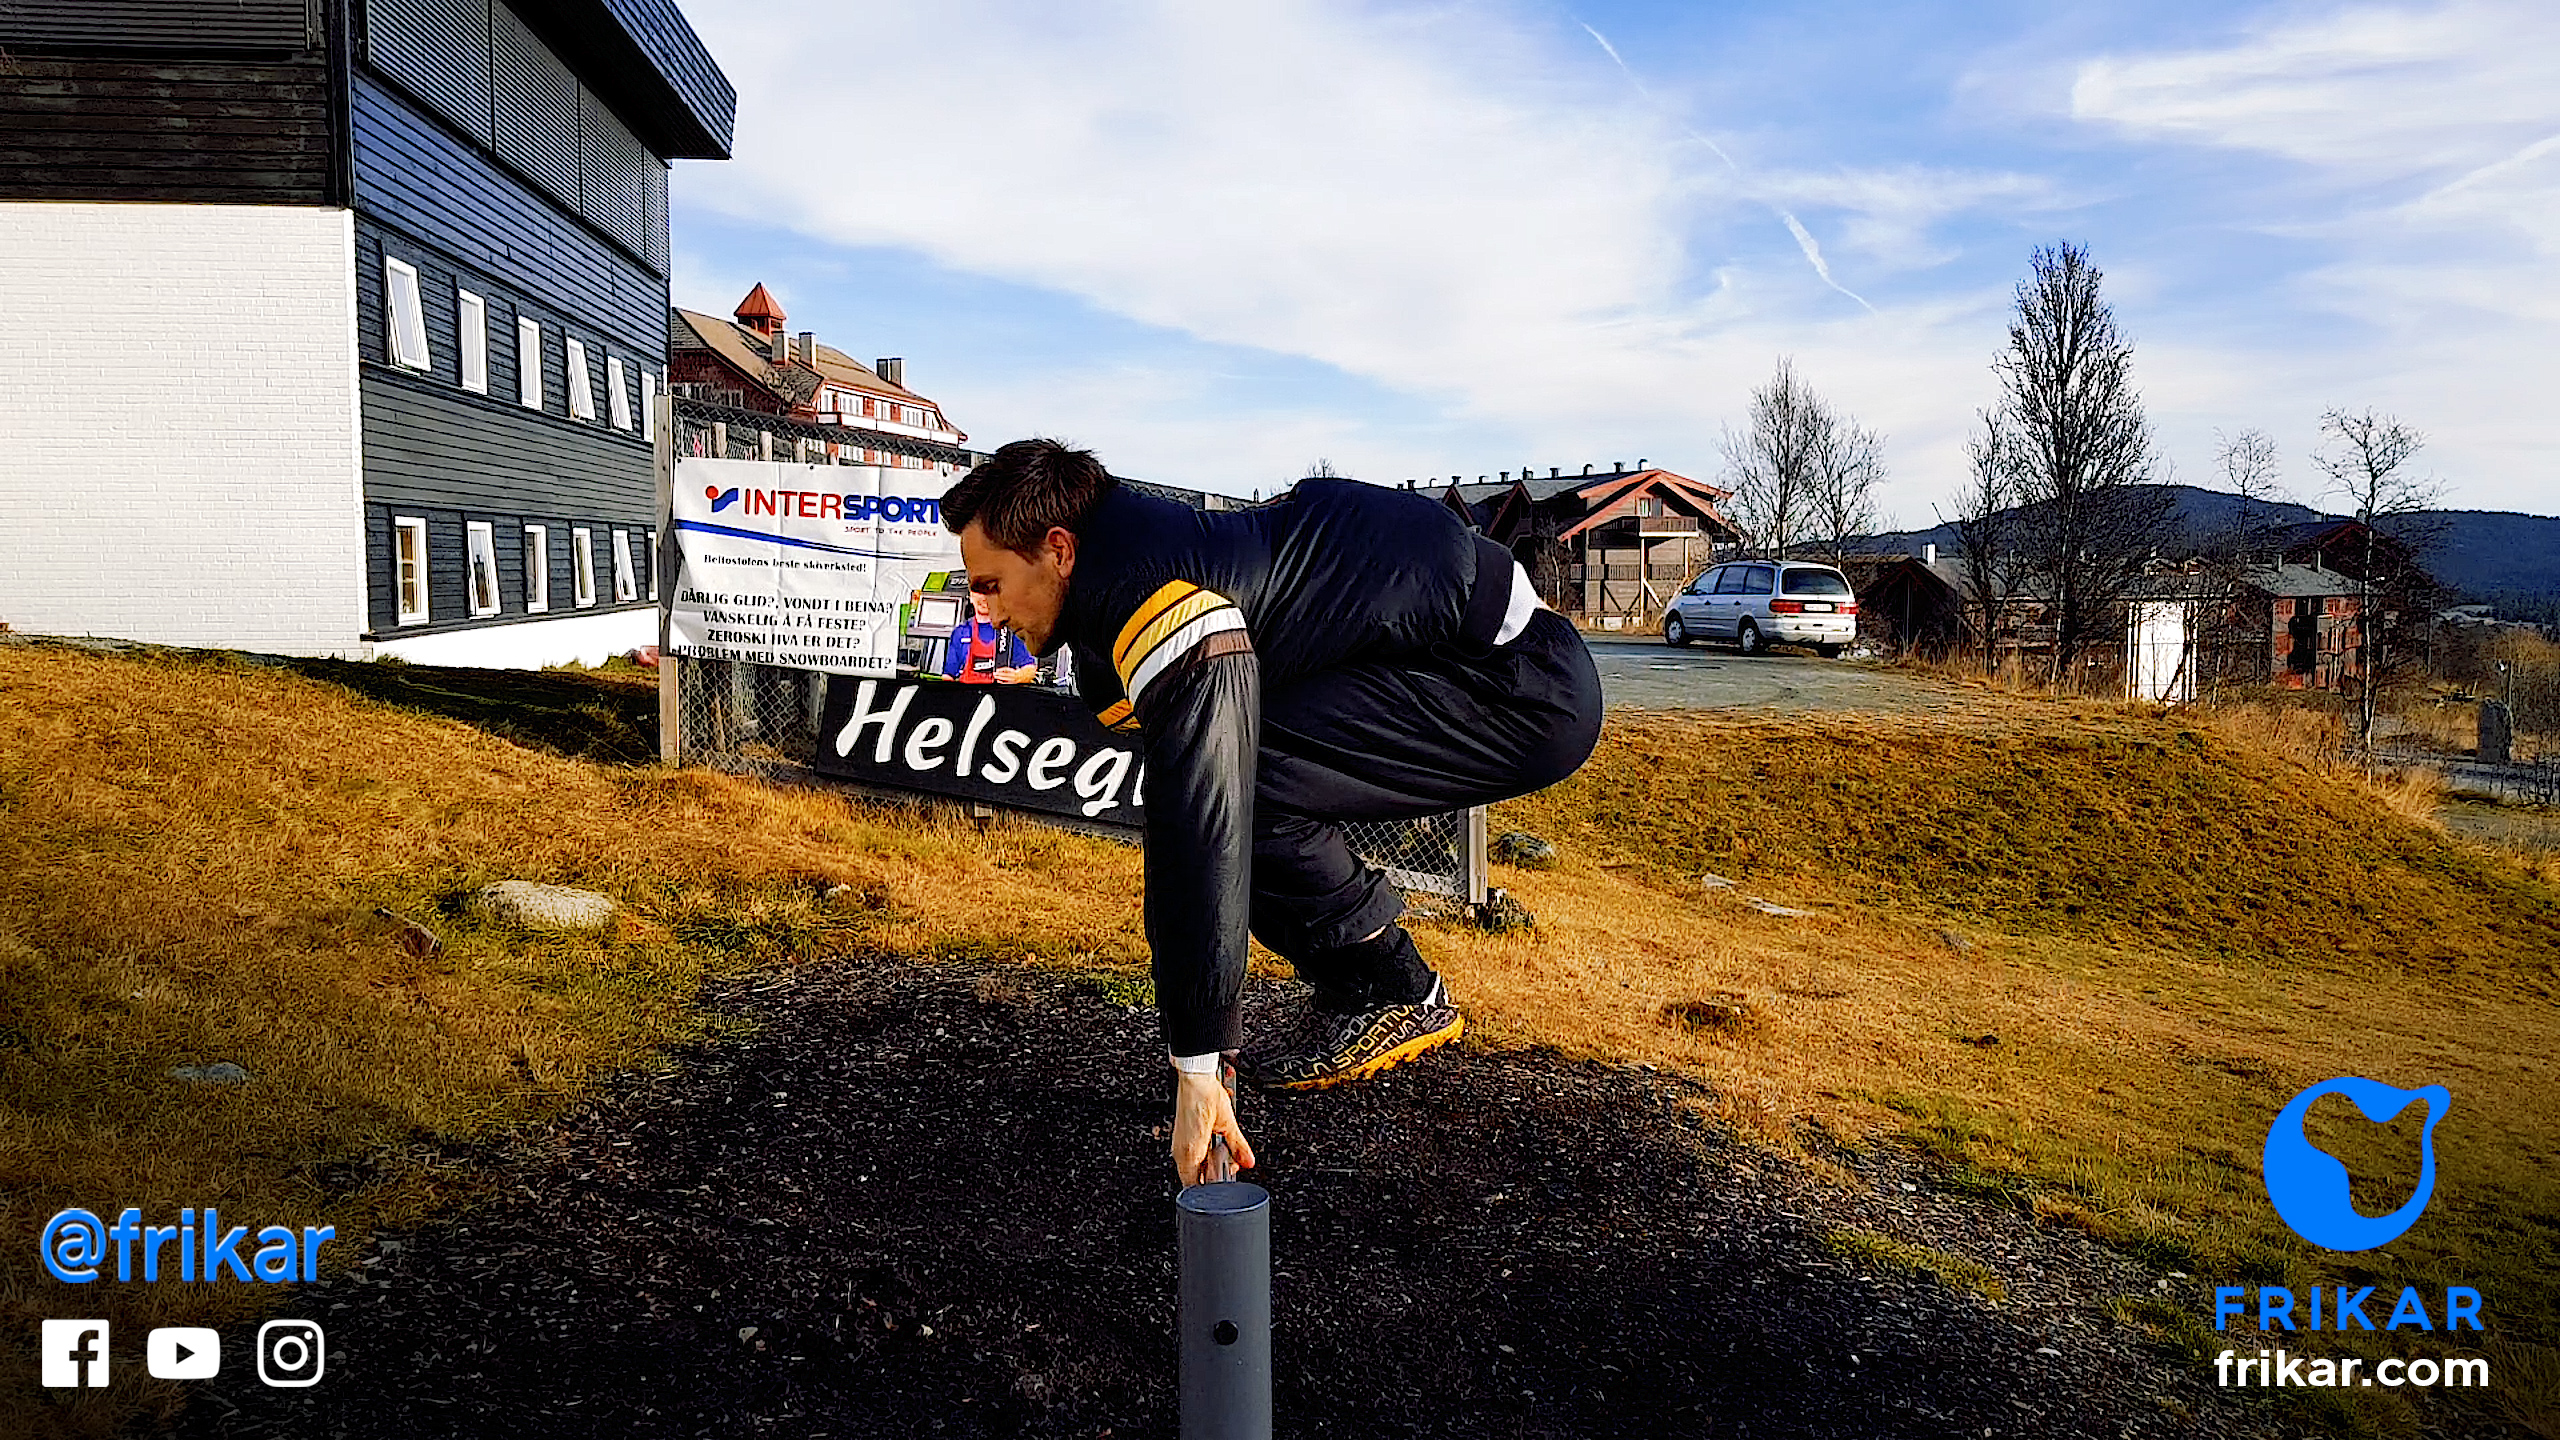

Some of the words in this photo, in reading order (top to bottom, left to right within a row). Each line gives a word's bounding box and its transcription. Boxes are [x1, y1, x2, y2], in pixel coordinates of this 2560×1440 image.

[744, 488, 939, 524] INTERSPORT
[681, 588, 728, 605] DÅRLIG
[784, 597, 830, 612] VONDT
[844, 600, 894, 615] BEINA?
[703, 610, 778, 627] VANSKELIG
[818, 617, 866, 632] FESTE?
[707, 628, 766, 645] ZEROSKI
[803, 636, 821, 648] ER
[826, 636, 861, 650] DET?
[678, 644, 741, 661] PROBLEM
[745, 650, 775, 664] MED
[779, 652, 893, 671] SNOWBOARDET?
